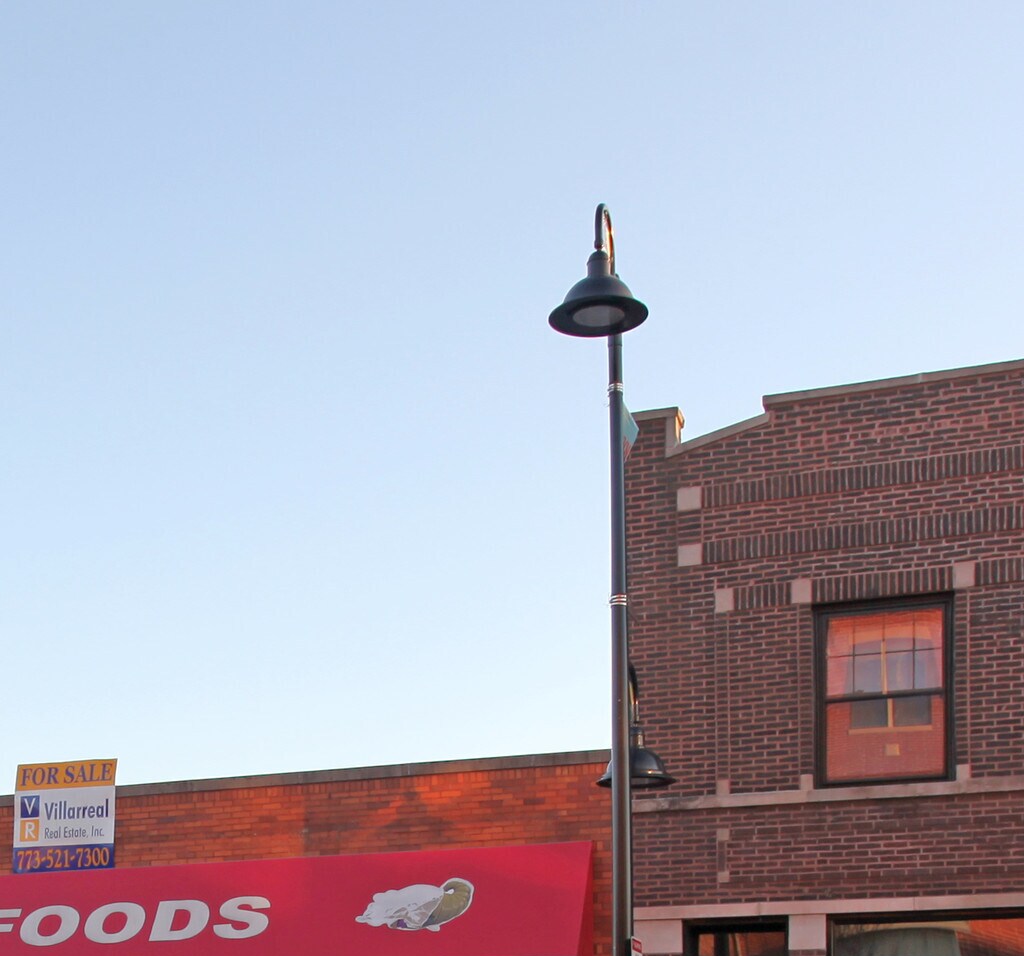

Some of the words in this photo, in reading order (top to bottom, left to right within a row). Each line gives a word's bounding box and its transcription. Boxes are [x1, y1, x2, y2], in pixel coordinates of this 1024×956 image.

[21, 767, 58, 786] FOR
[64, 763, 113, 783] SALE
[44, 798, 108, 820] Villarreal
[44, 827, 60, 839] Real
[64, 826, 88, 838] Estate,
[92, 826, 104, 837] Inc.
[17, 847, 110, 870] 773-521-7300
